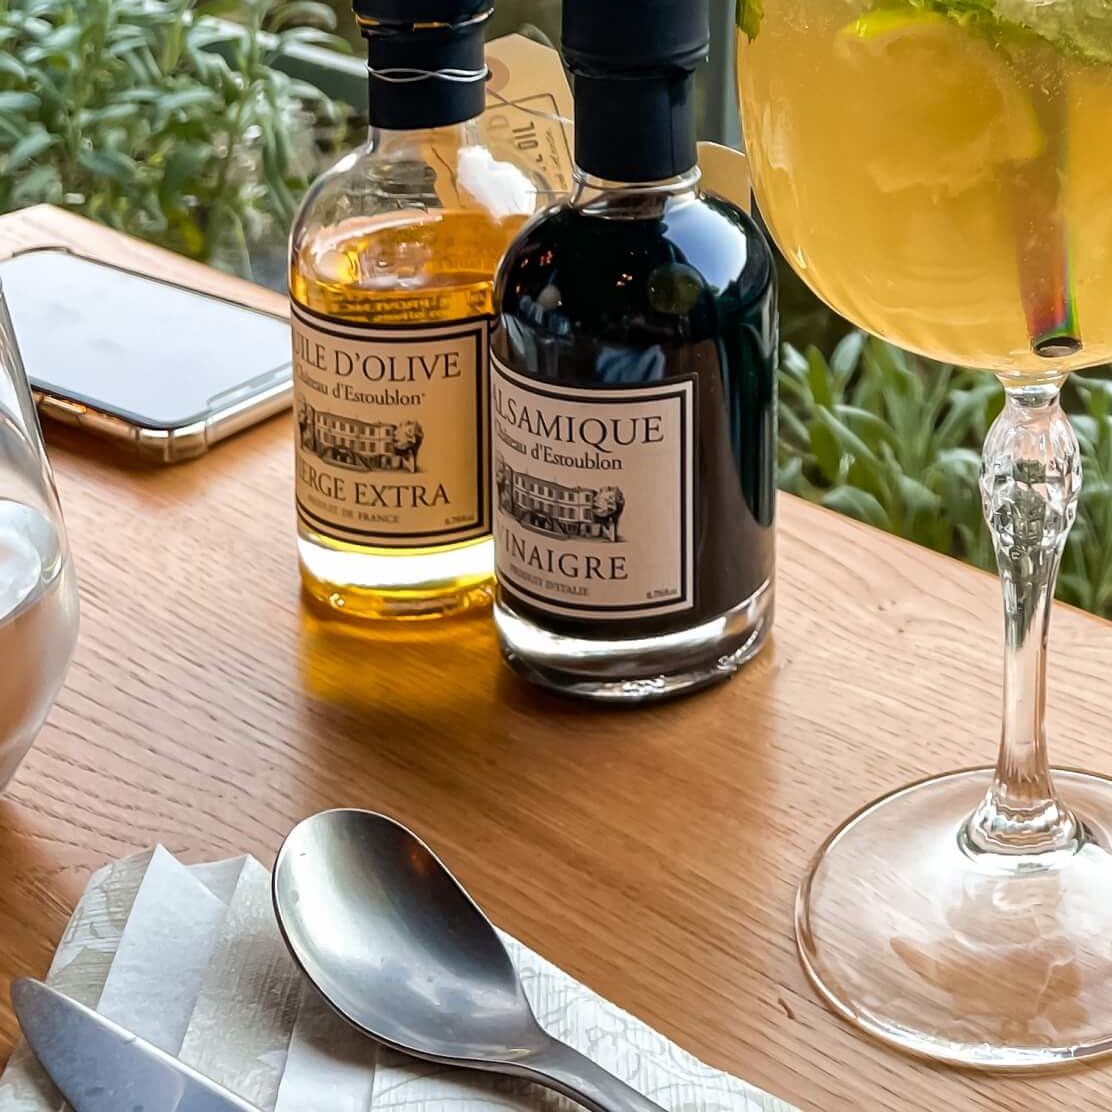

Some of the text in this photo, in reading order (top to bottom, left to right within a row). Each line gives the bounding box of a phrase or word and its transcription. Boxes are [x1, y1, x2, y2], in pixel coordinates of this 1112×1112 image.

[334, 350, 462, 382] D'OLIVE
[531, 442, 623, 470] d'Estoublon
[353, 482, 450, 508] EXTRA
[358, 512, 400, 524] FRANCE
